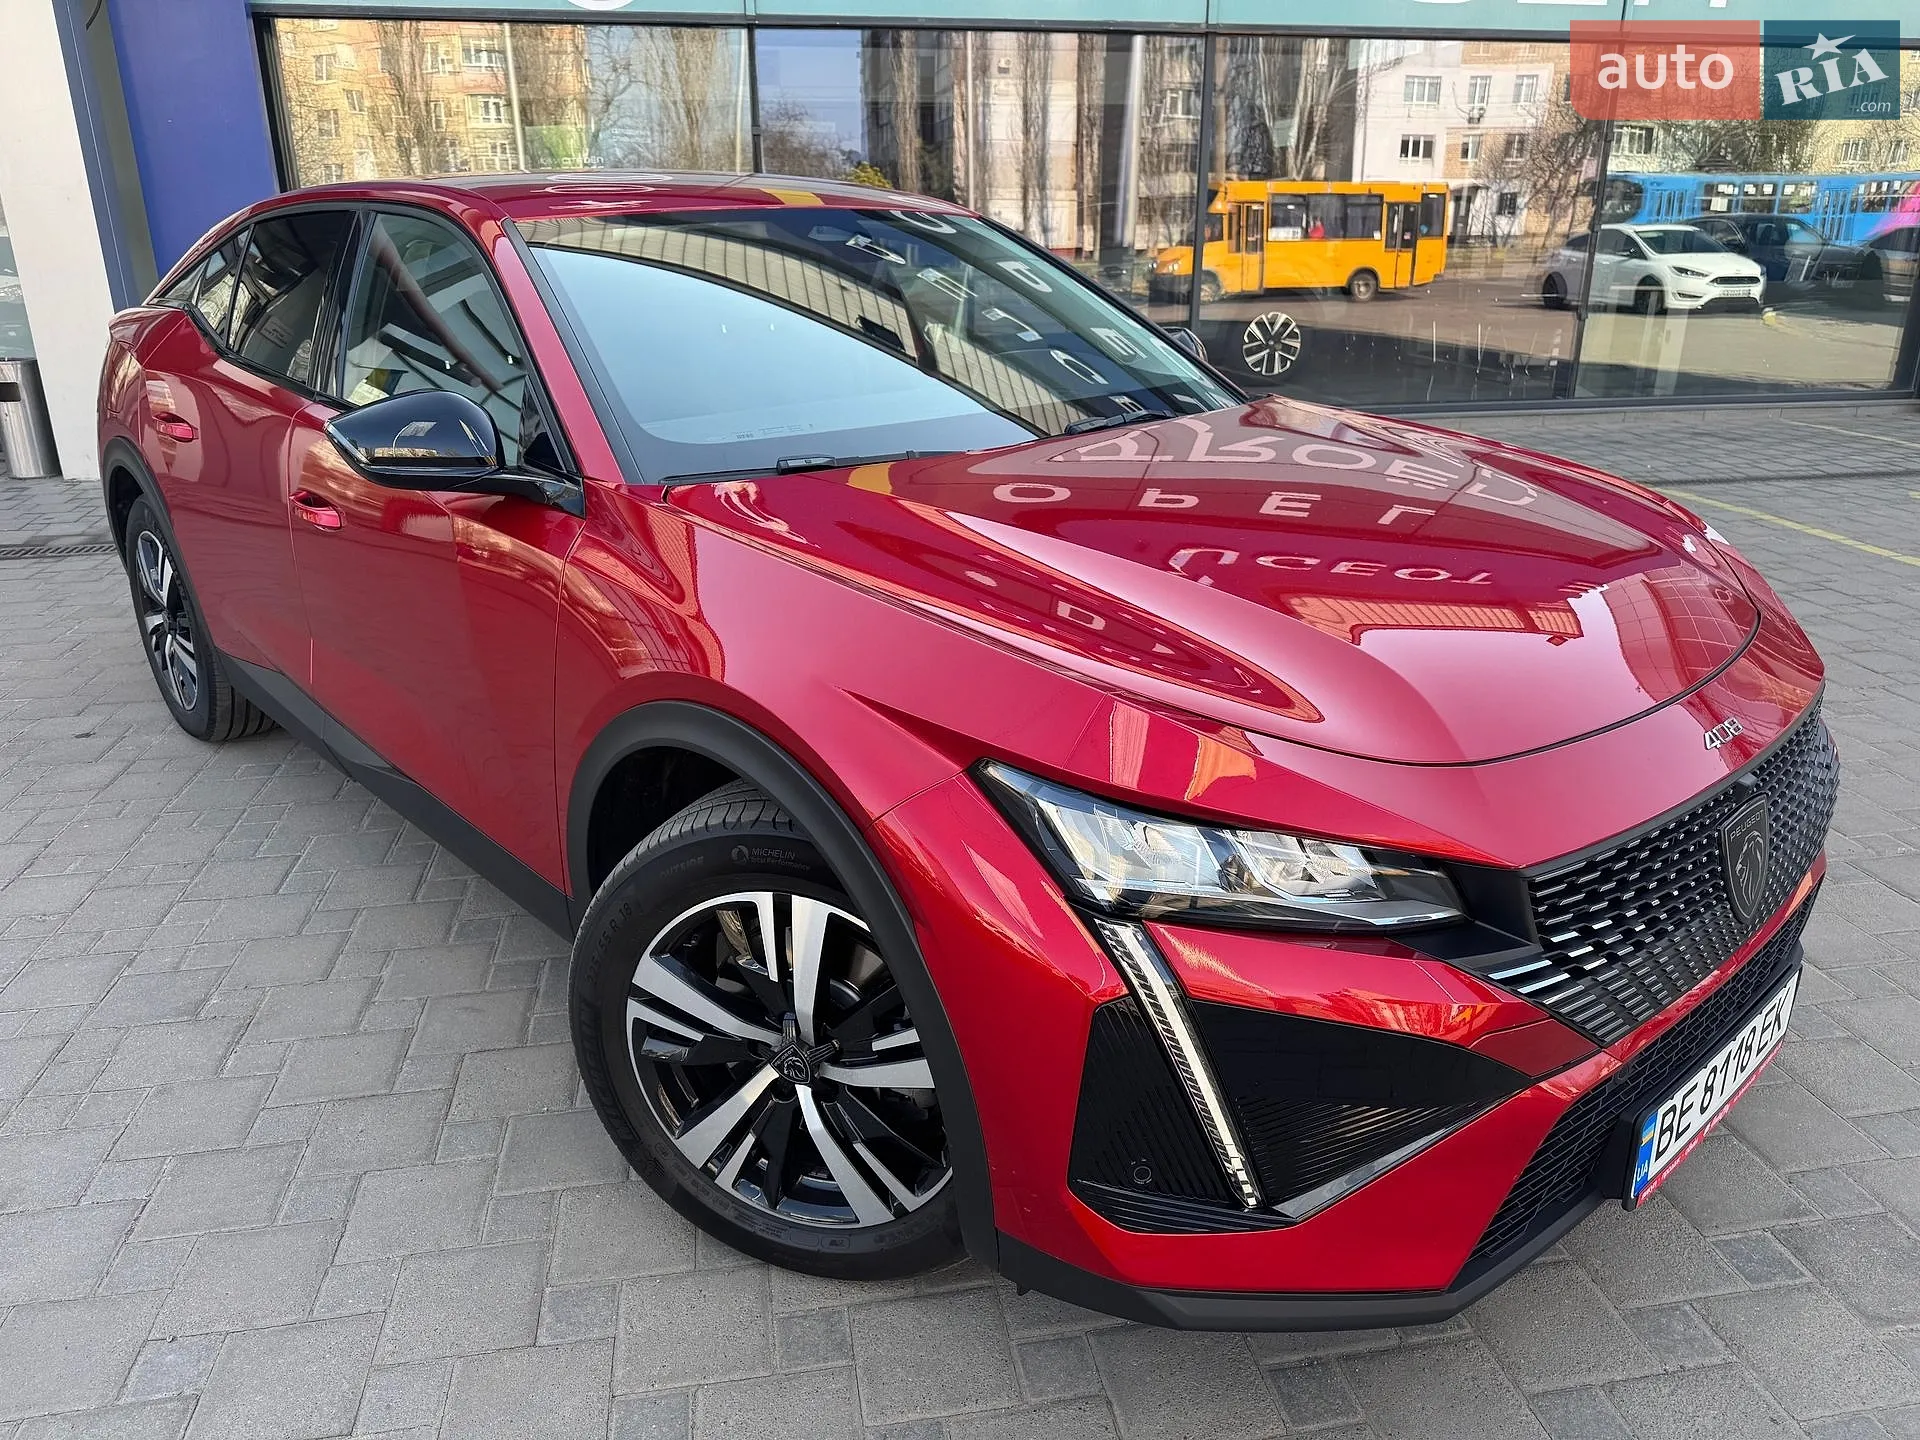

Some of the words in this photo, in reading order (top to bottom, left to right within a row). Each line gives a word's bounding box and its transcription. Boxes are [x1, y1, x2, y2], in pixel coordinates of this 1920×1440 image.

[1704, 716, 1743, 750] 408
[1730, 809, 1764, 843] PEUGEOT
[751, 847, 796, 861] MICHELIN
[1655, 1082, 1698, 1162] BE
[1700, 1025, 1757, 1115] 8118
[1756, 985, 1791, 1058] EK
[1637, 1159, 1648, 1182] UA
